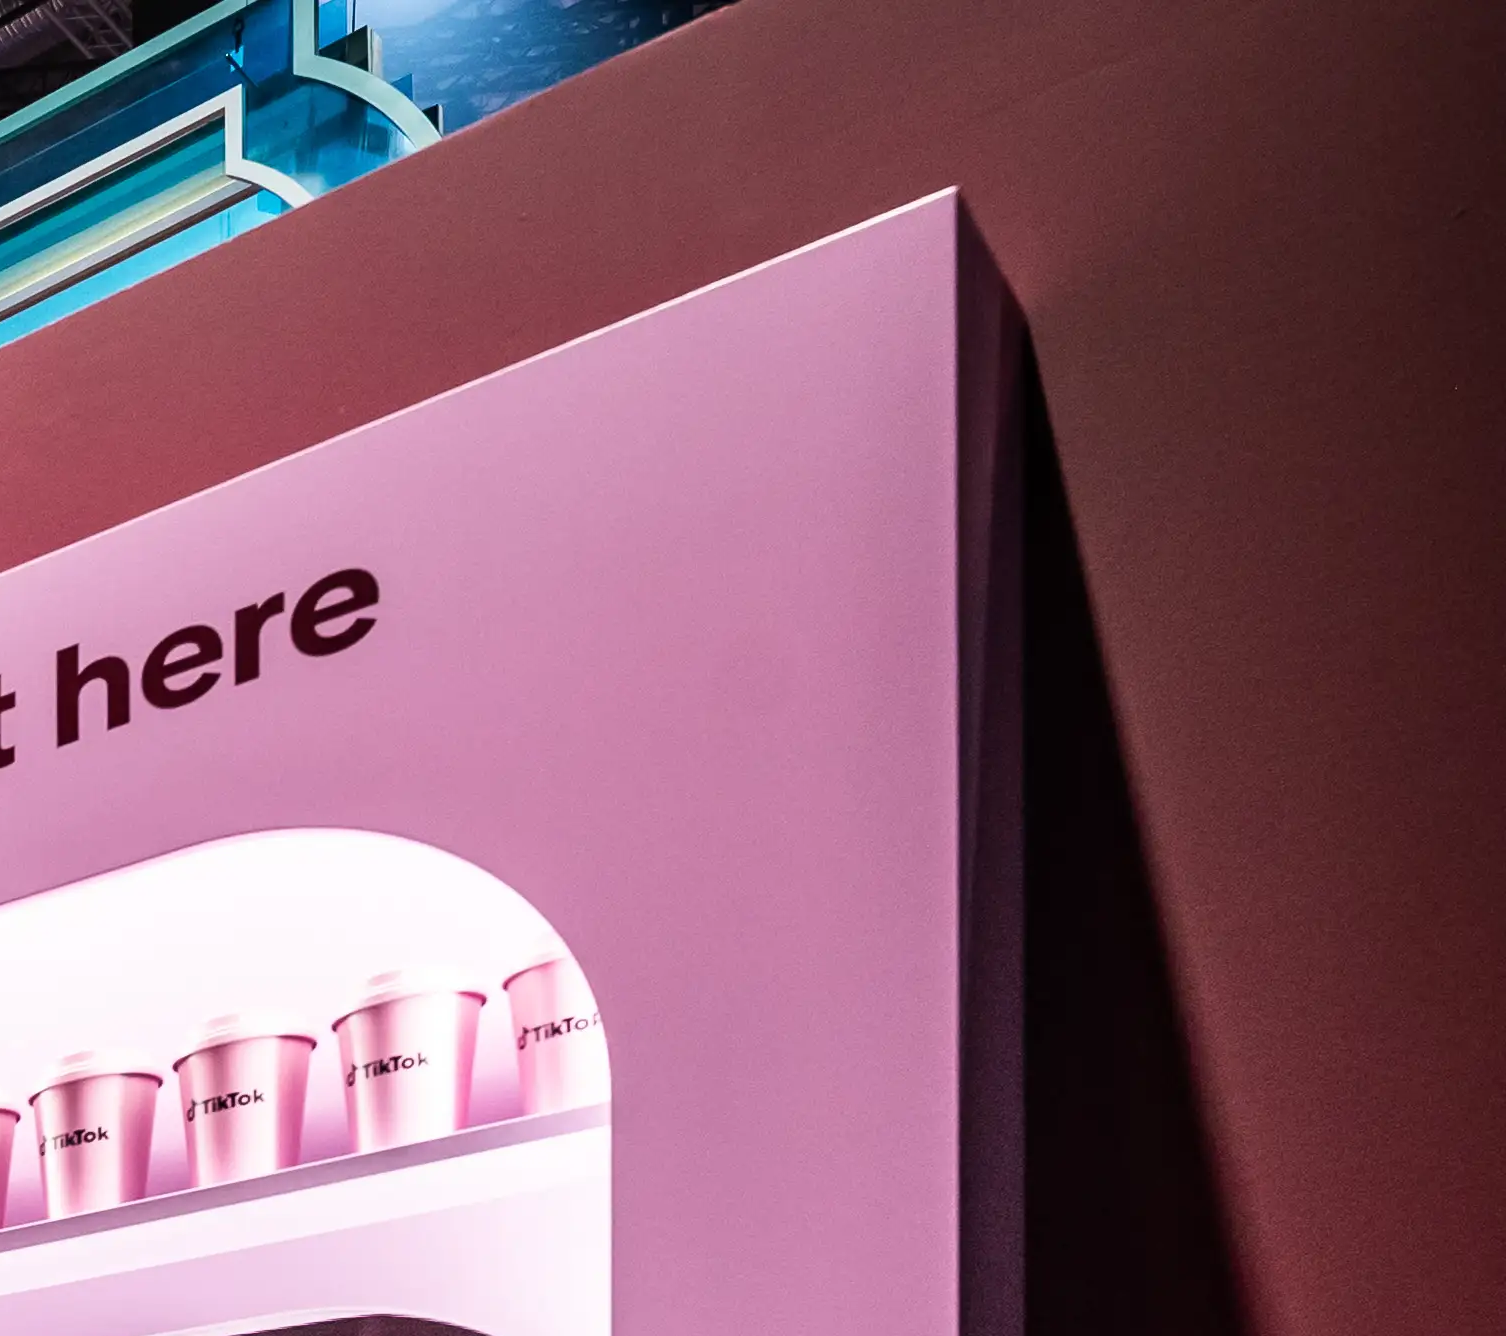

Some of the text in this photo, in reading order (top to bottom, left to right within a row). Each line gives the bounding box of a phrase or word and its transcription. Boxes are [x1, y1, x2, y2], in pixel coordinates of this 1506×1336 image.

[54, 565, 383, 748] here
[362, 1053, 429, 1080] TikTok
[202, 1089, 265, 1115] TikTok
[52, 1126, 109, 1151] TikTok
